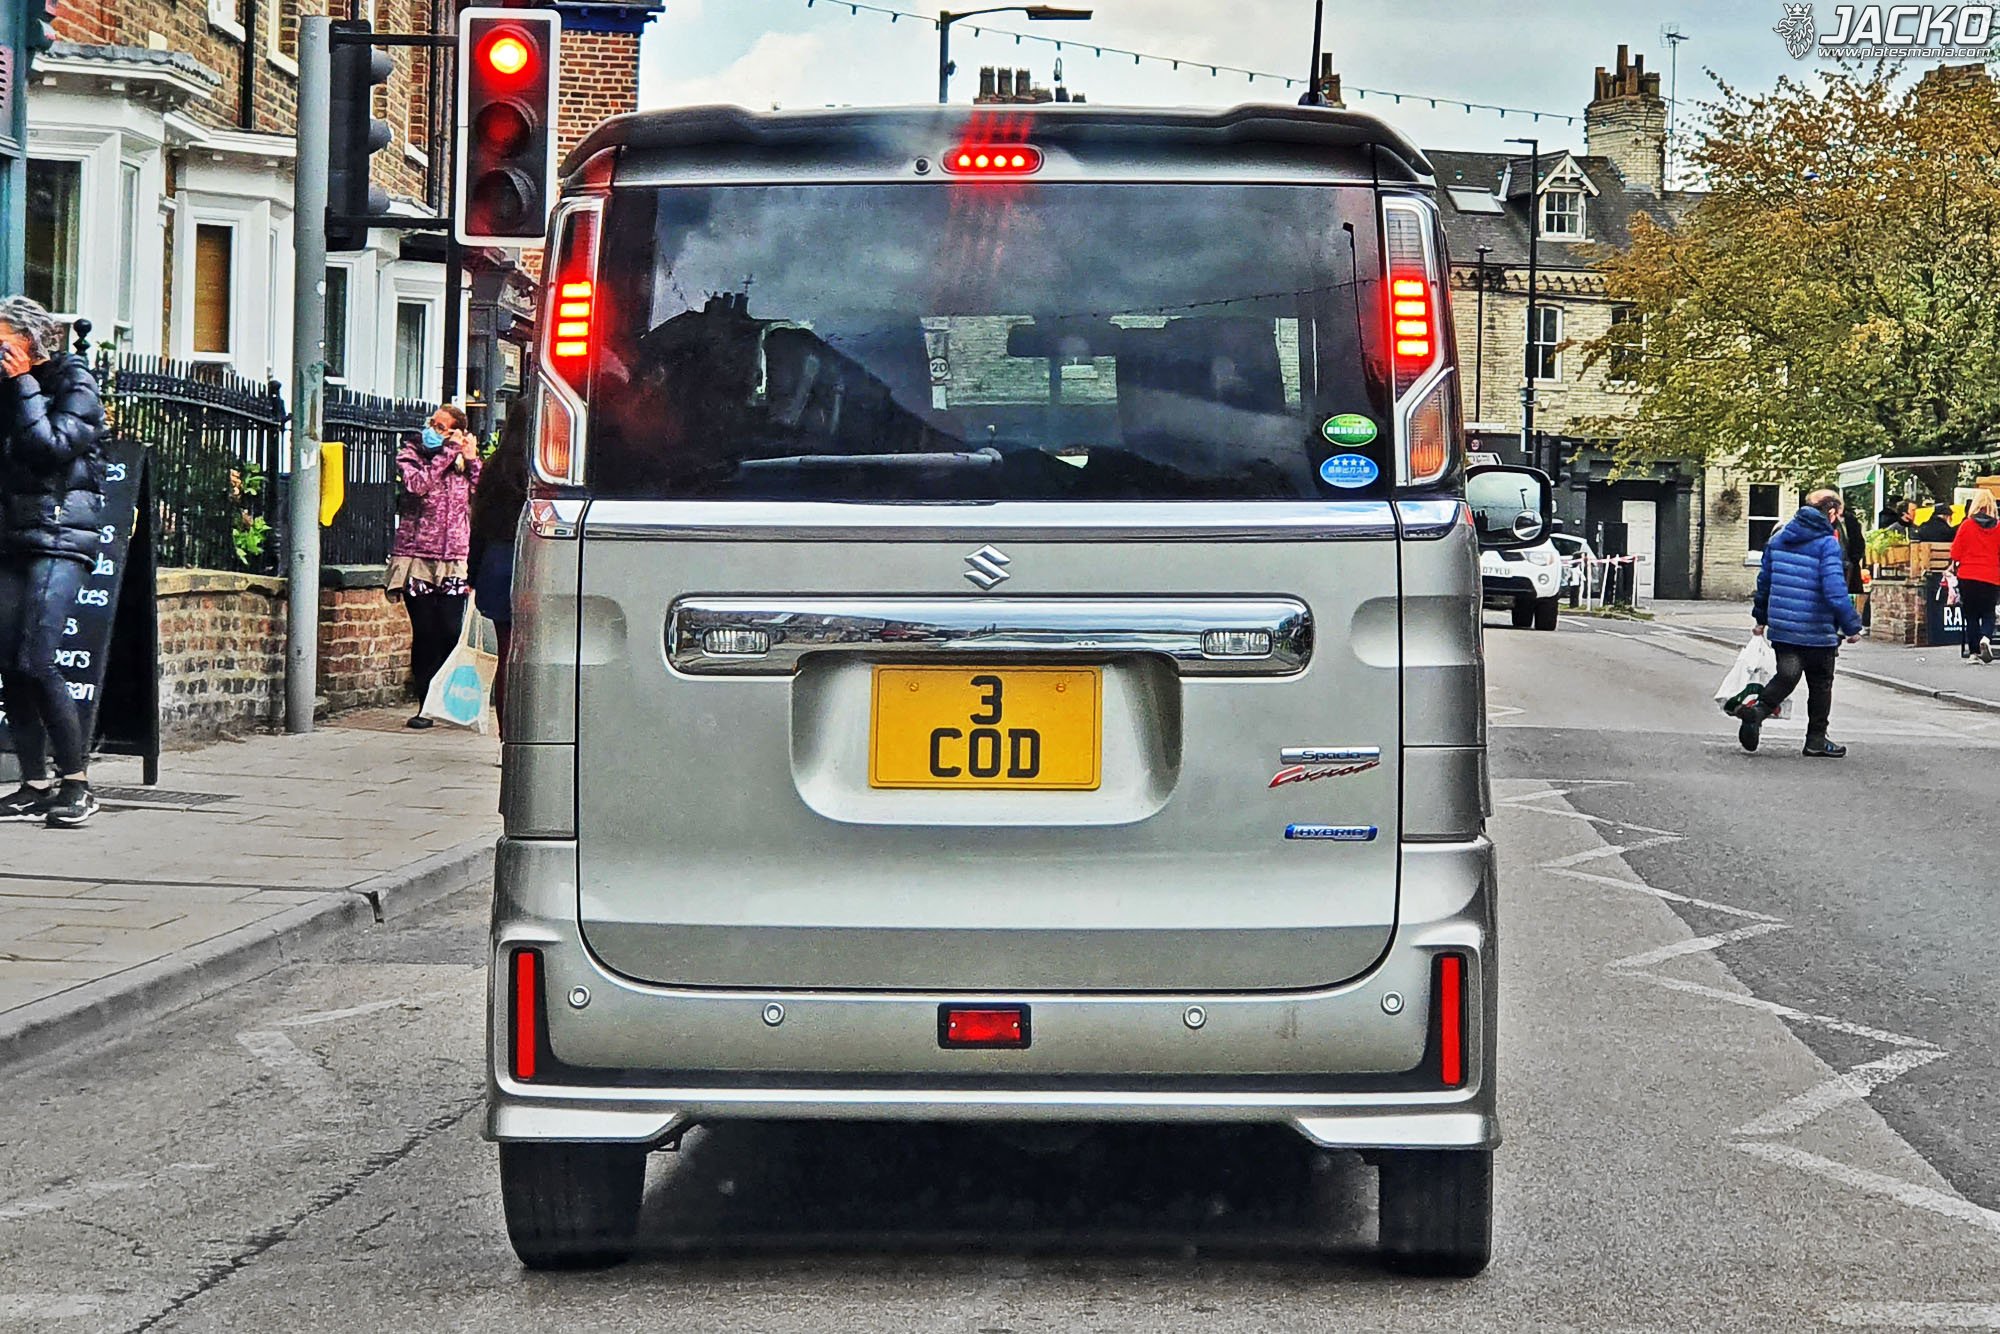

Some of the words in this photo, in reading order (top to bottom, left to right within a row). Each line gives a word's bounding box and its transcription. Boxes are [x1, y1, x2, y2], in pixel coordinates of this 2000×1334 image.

[931, 362, 946, 373] 20
[970, 675, 1003, 725] 3
[929, 727, 1041, 779] COD
[1299, 828, 1365, 837] HYBRID
